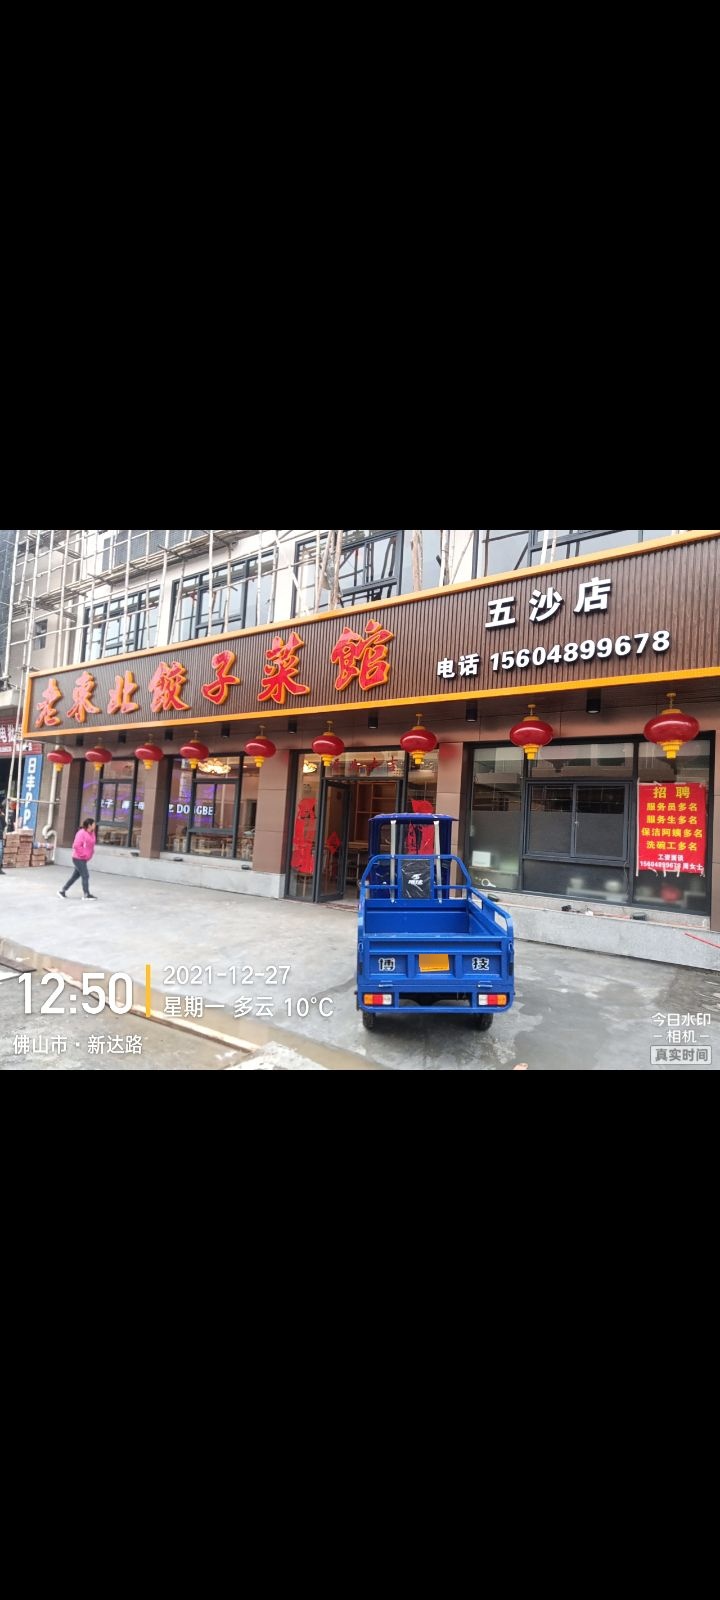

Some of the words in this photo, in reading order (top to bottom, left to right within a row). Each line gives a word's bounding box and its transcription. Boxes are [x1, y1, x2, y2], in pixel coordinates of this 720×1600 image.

[484, 576, 612, 629] 五沙店
[436, 653, 480, 679] 电话
[490, 630, 671, 671] 15604899678
[652, 786, 691, 799] 招聘
[646, 802, 698, 812] 服务员多名
[646, 815, 698, 825] 服务生多名
[641, 827, 703, 838] 保洁阿姨多名
[646, 840, 698, 852] 洗碗工多名
[472, 957, 489, 971] 技
